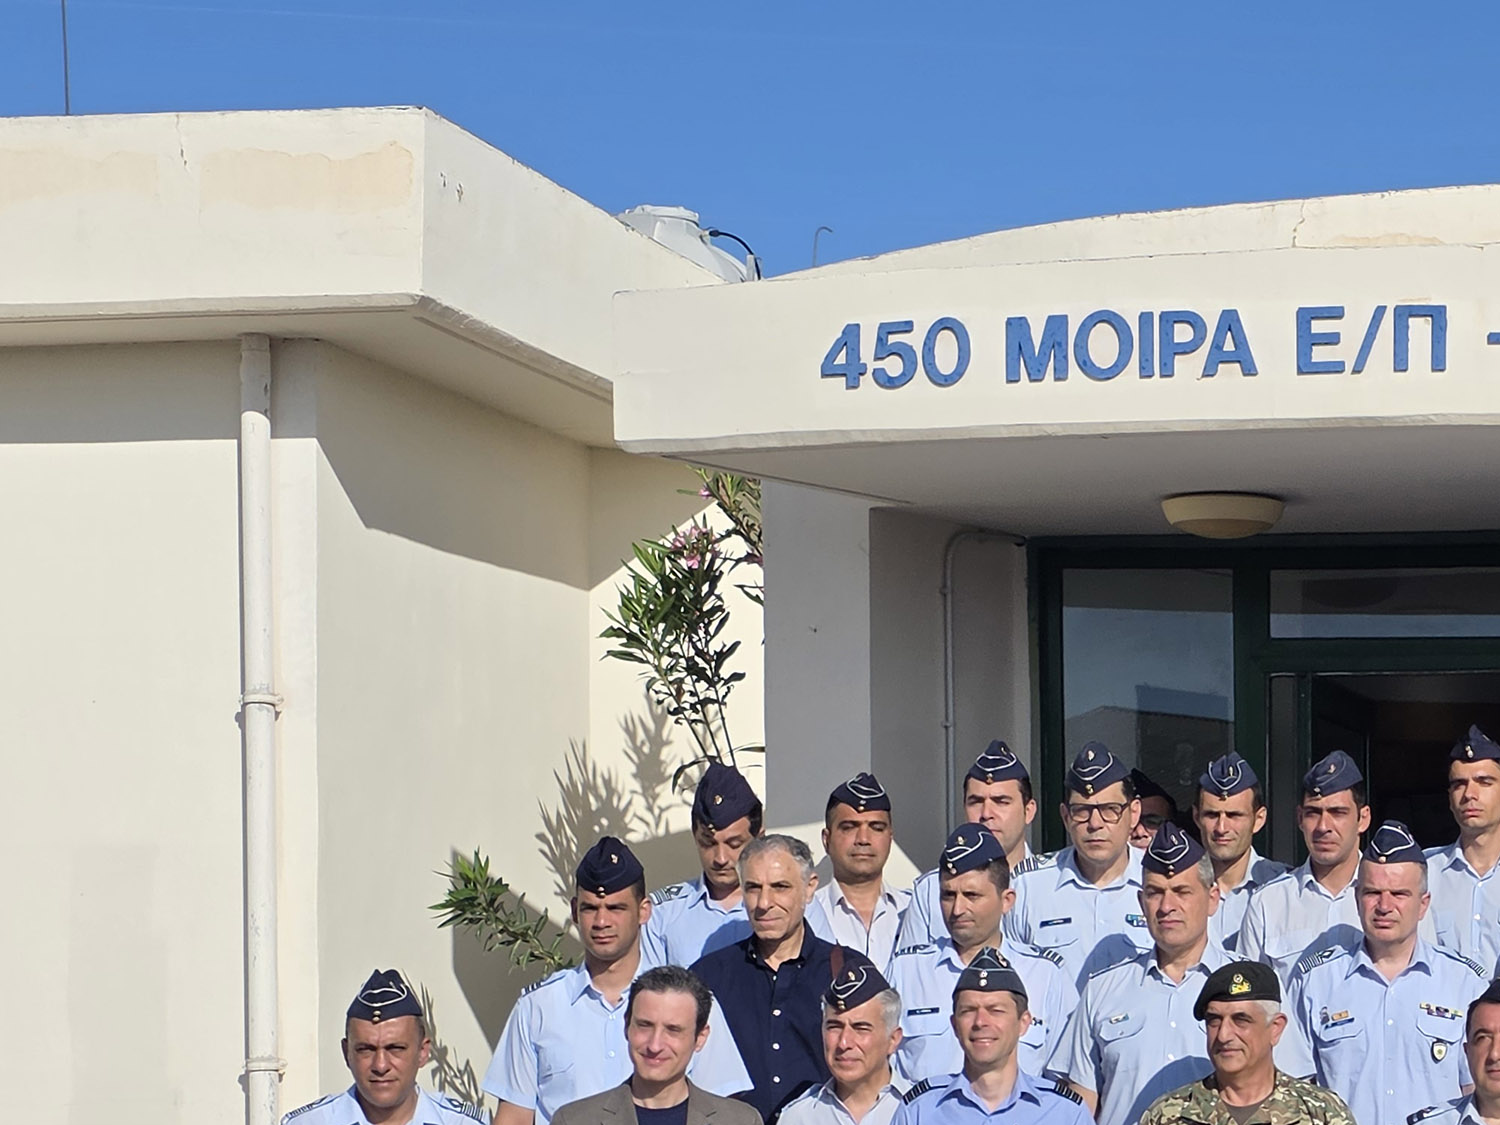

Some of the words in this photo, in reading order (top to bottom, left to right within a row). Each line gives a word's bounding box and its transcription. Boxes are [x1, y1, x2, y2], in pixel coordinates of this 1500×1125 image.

[821, 317, 970, 387] 450
[1004, 309, 1257, 381] ΜΟΙΡΑ
[1295, 305, 1448, 374] Ε/Π
